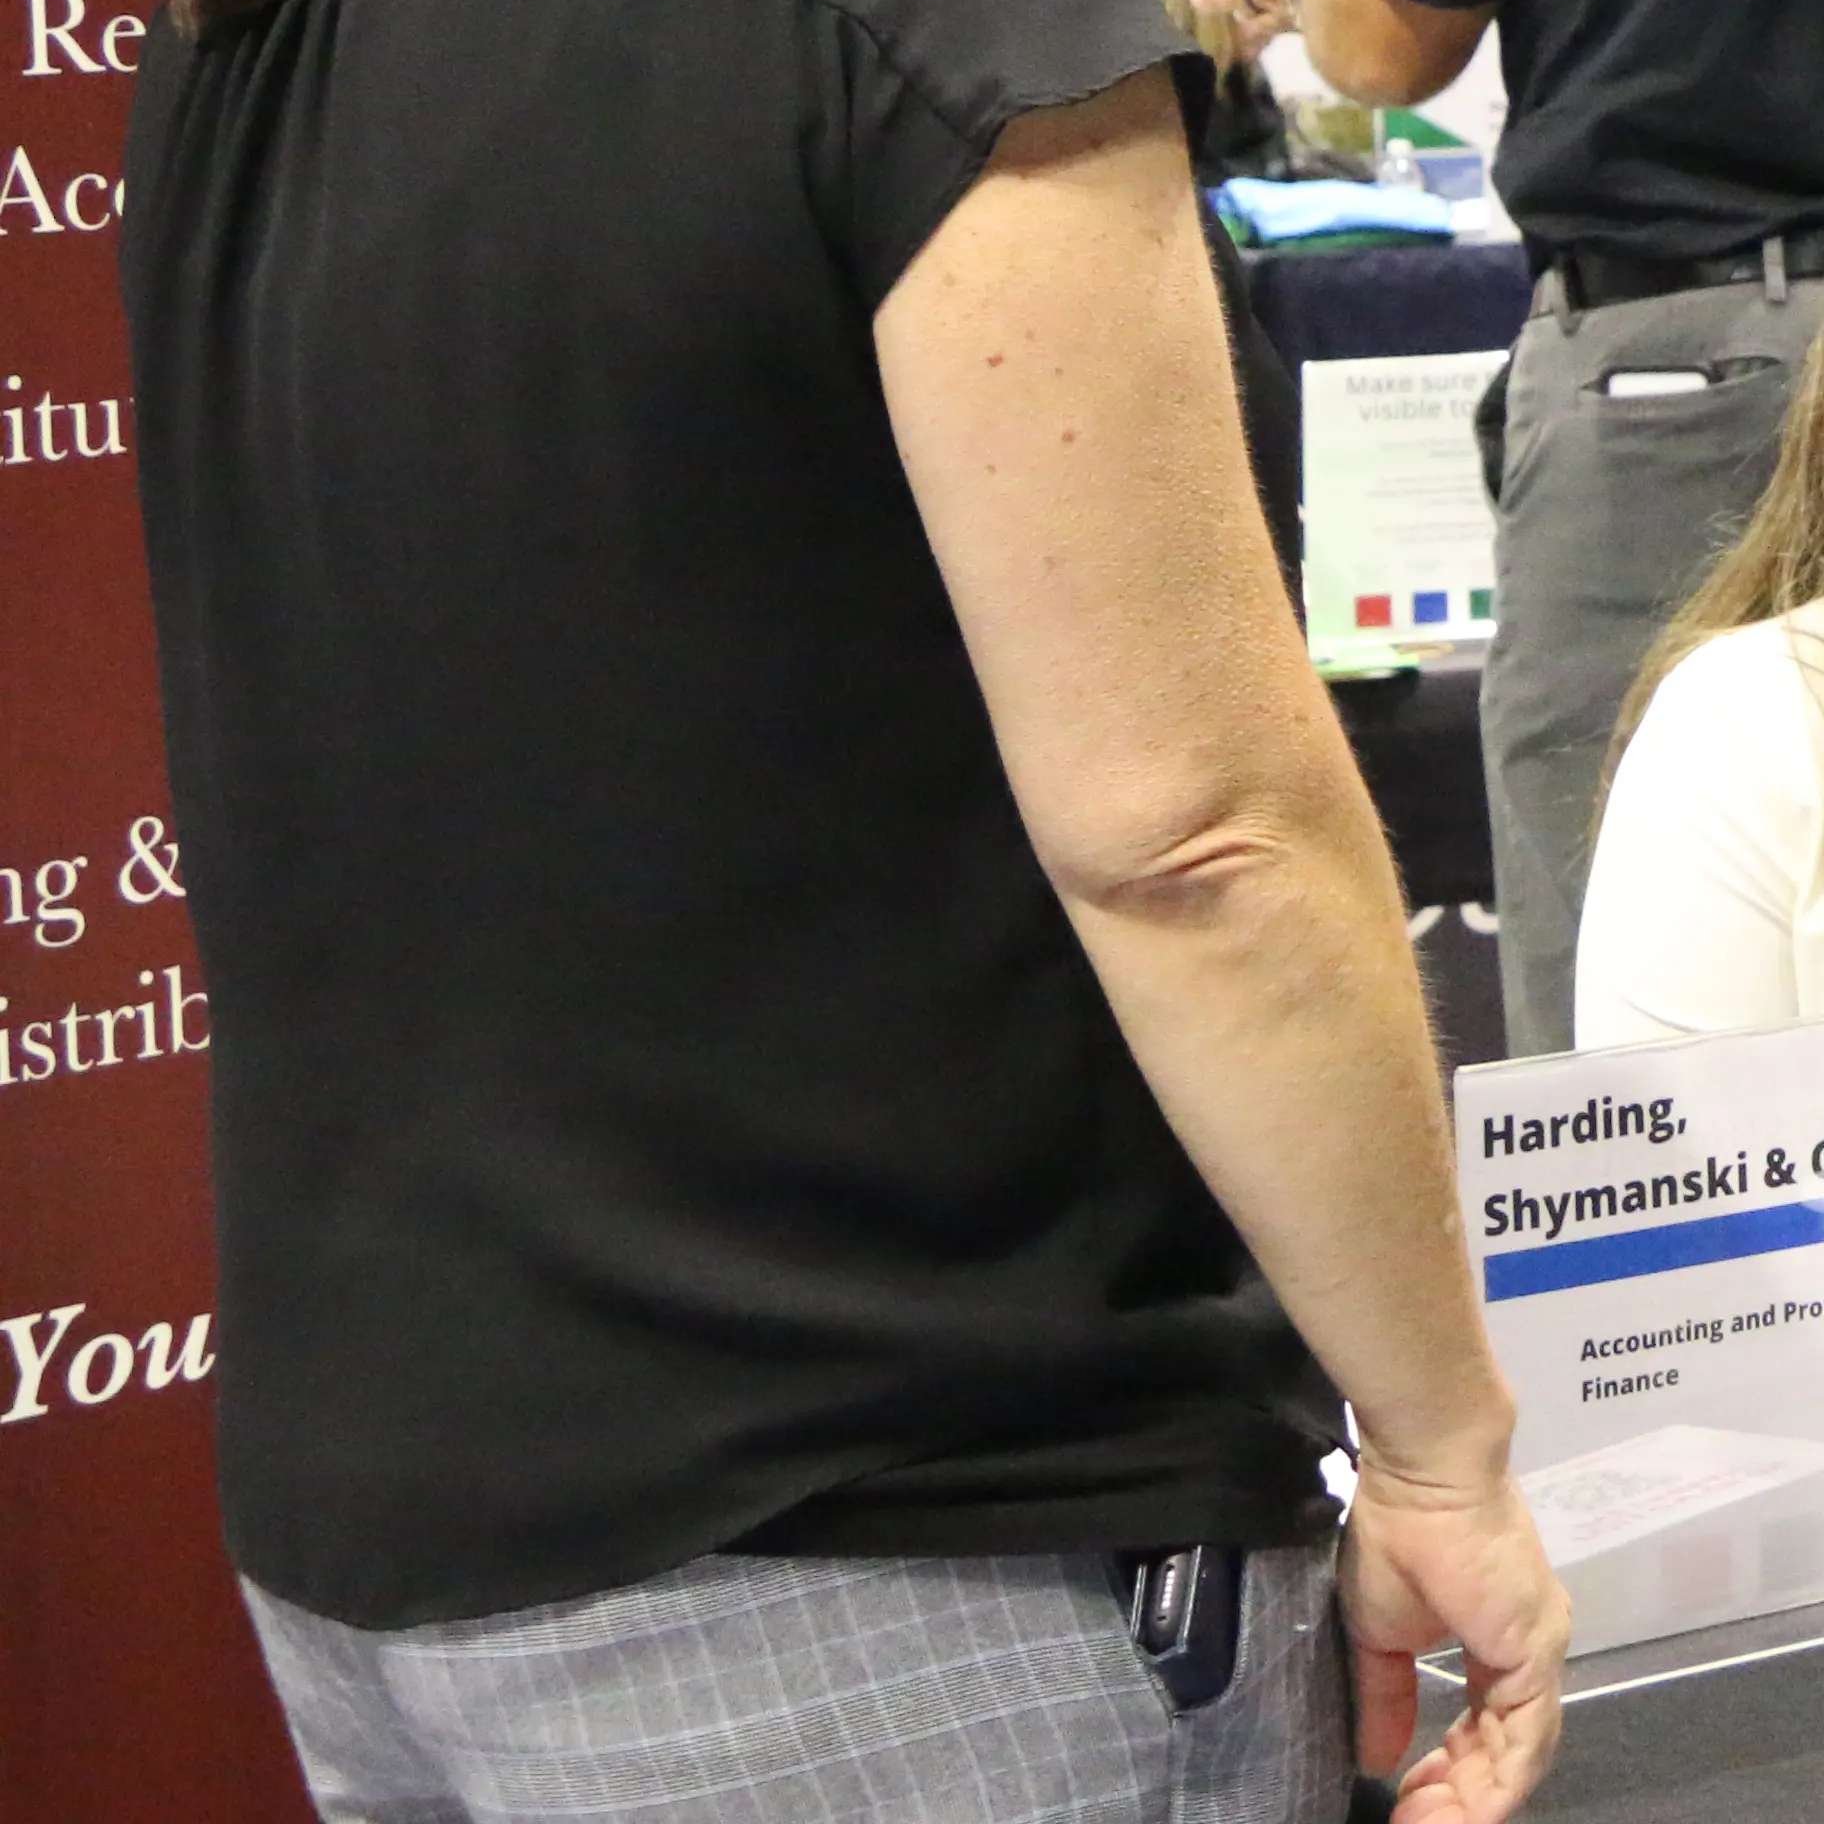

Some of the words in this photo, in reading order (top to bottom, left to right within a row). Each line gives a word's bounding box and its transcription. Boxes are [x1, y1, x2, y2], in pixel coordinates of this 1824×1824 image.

[1346, 375, 1414, 395] Make
[1421, 373, 1478, 394] sure
[1358, 399, 1443, 422] visible
[0, 374, 136, 466] itu
[117, 815, 188, 905] &
[1482, 1096, 1688, 1159] Harding,
[1483, 1152, 1749, 1241] Shymanski
[1763, 1147, 1797, 1189] &
[0, 1302, 214, 1424] You
[1580, 1318, 1725, 1362] Accounting
[1731, 1304, 1776, 1334] and
[1581, 1367, 1680, 1403] Finance
